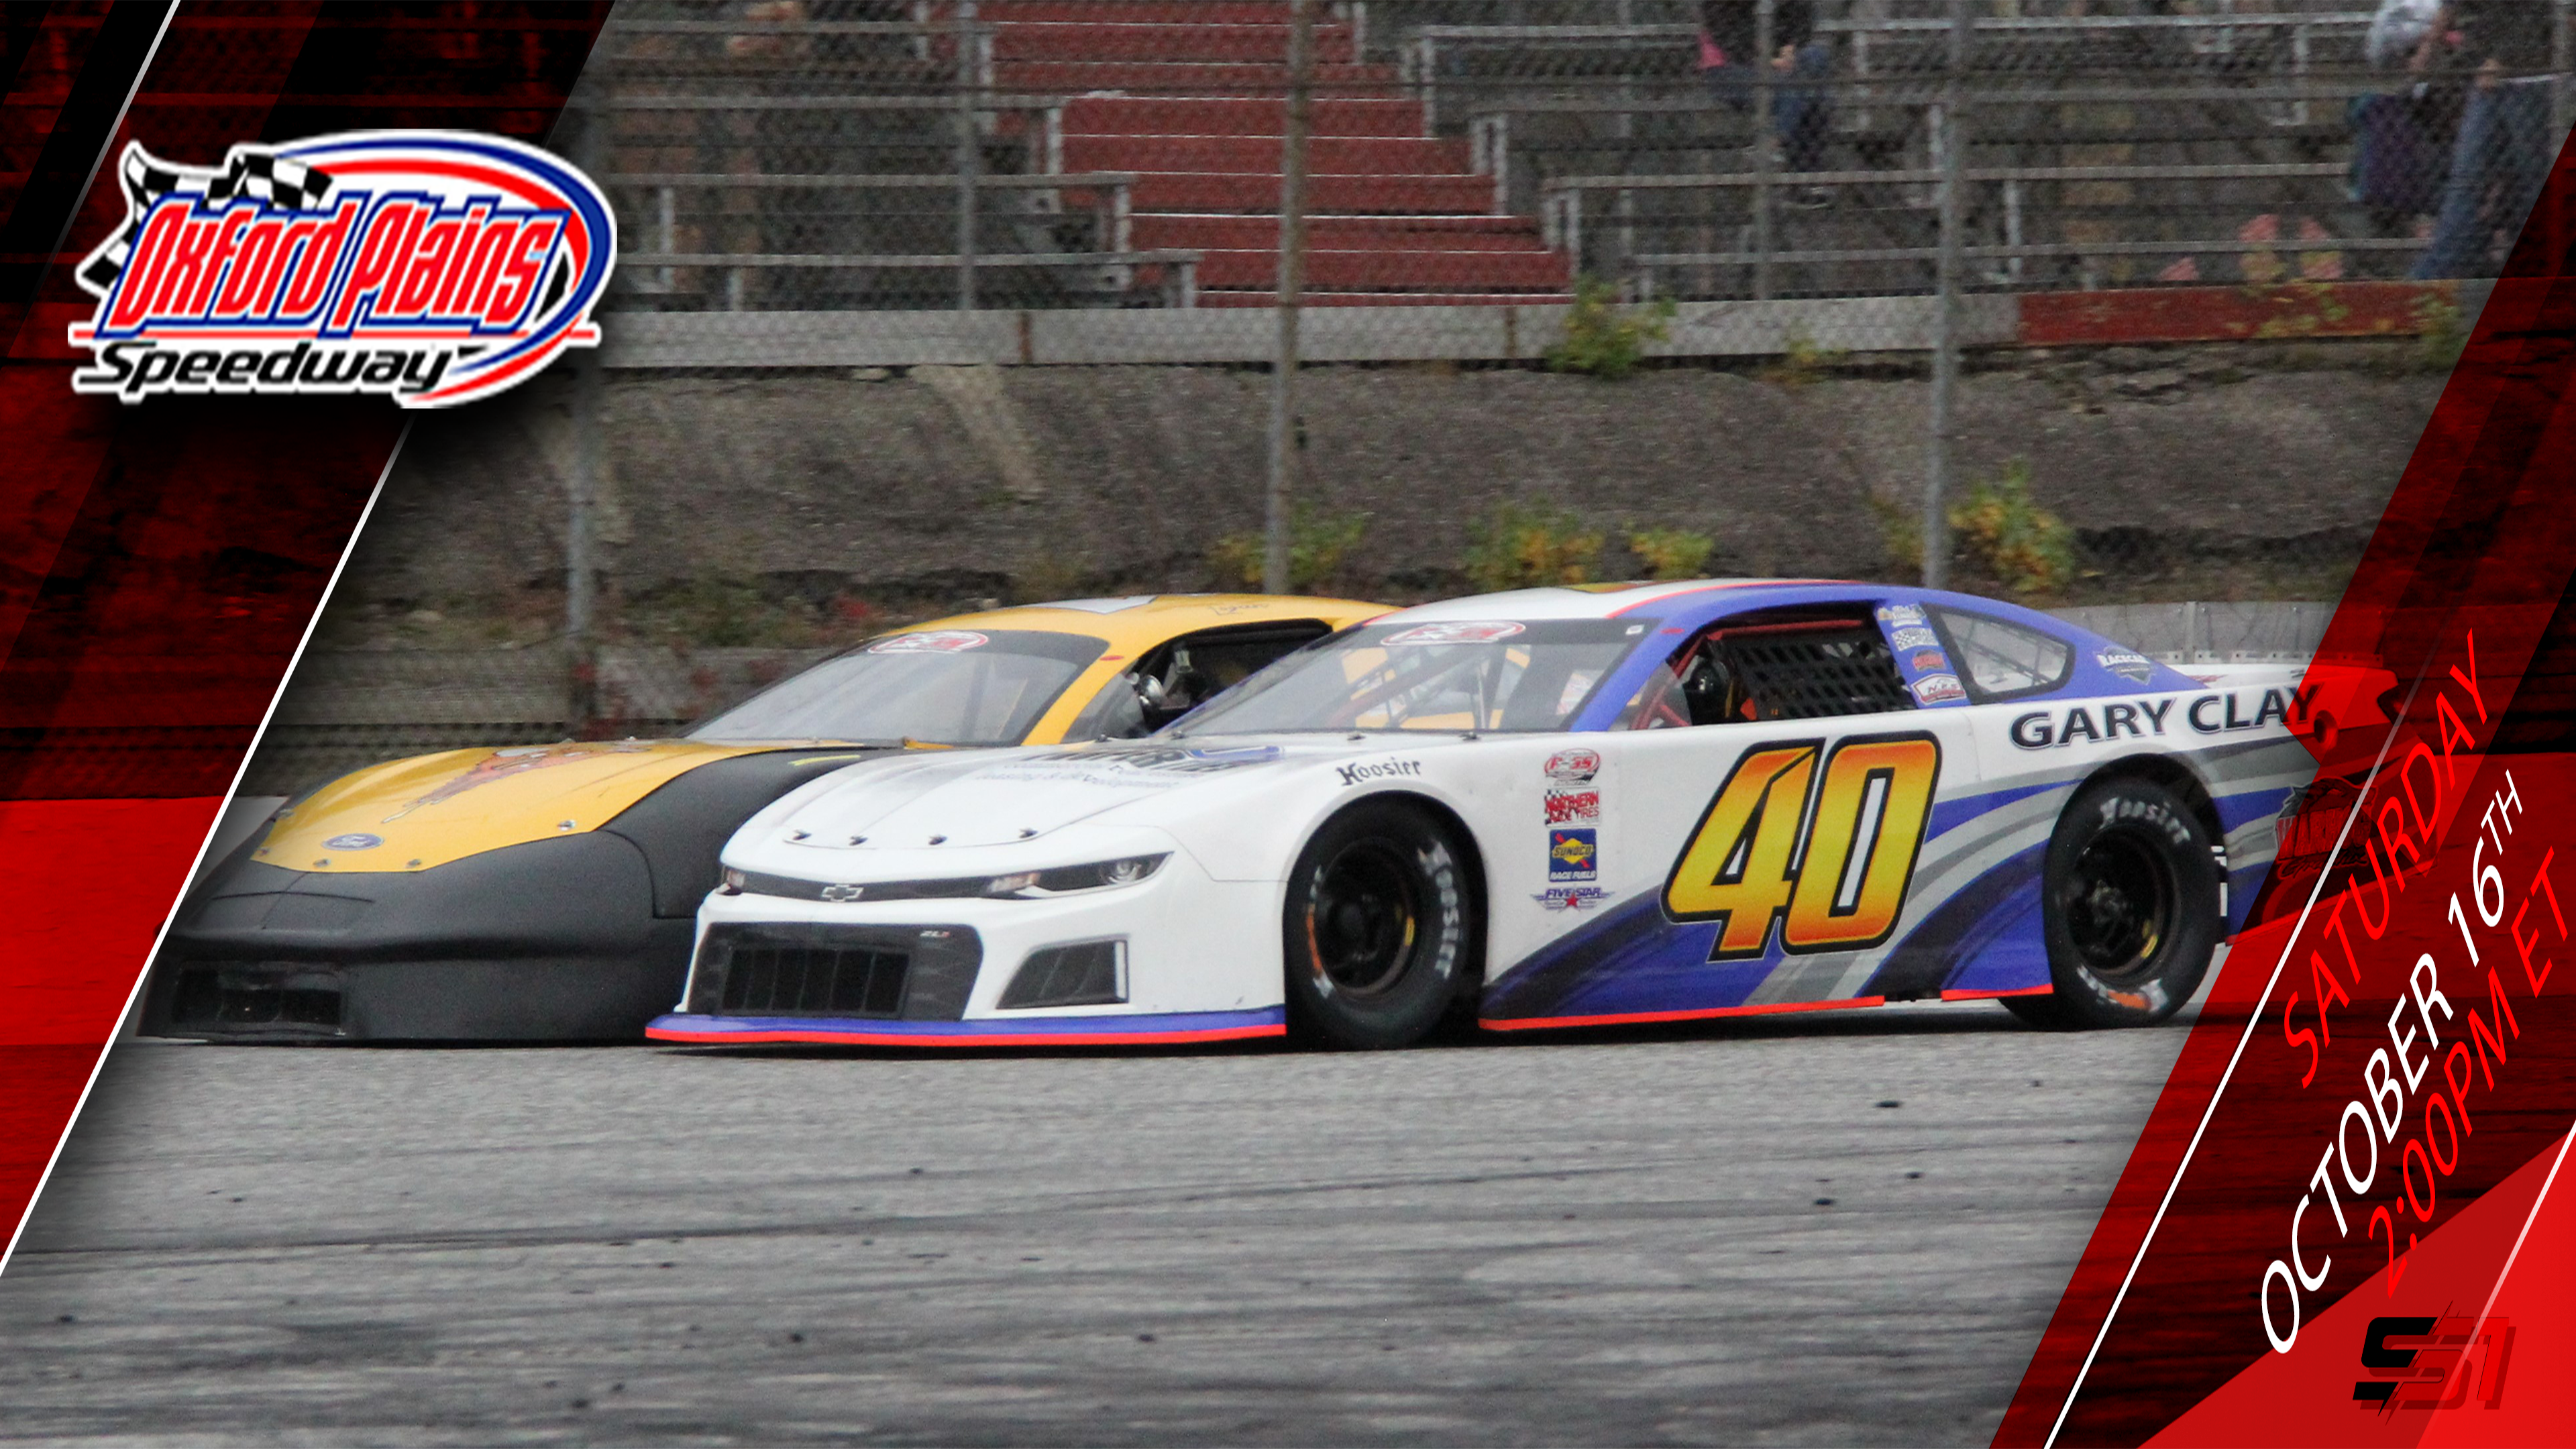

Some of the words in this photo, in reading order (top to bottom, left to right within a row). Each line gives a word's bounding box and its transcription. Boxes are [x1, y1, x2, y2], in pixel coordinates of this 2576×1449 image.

[2009, 696, 2176, 751] GARY
[2187, 682, 2324, 733] CLAY
[1336, 756, 1421, 786] Hoosier
[1554, 845, 1593, 858] SUNOCO
[1660, 729, 1943, 963] 40
[1546, 888, 1573, 898] FIVE
[1575, 886, 1601, 897] STAR
